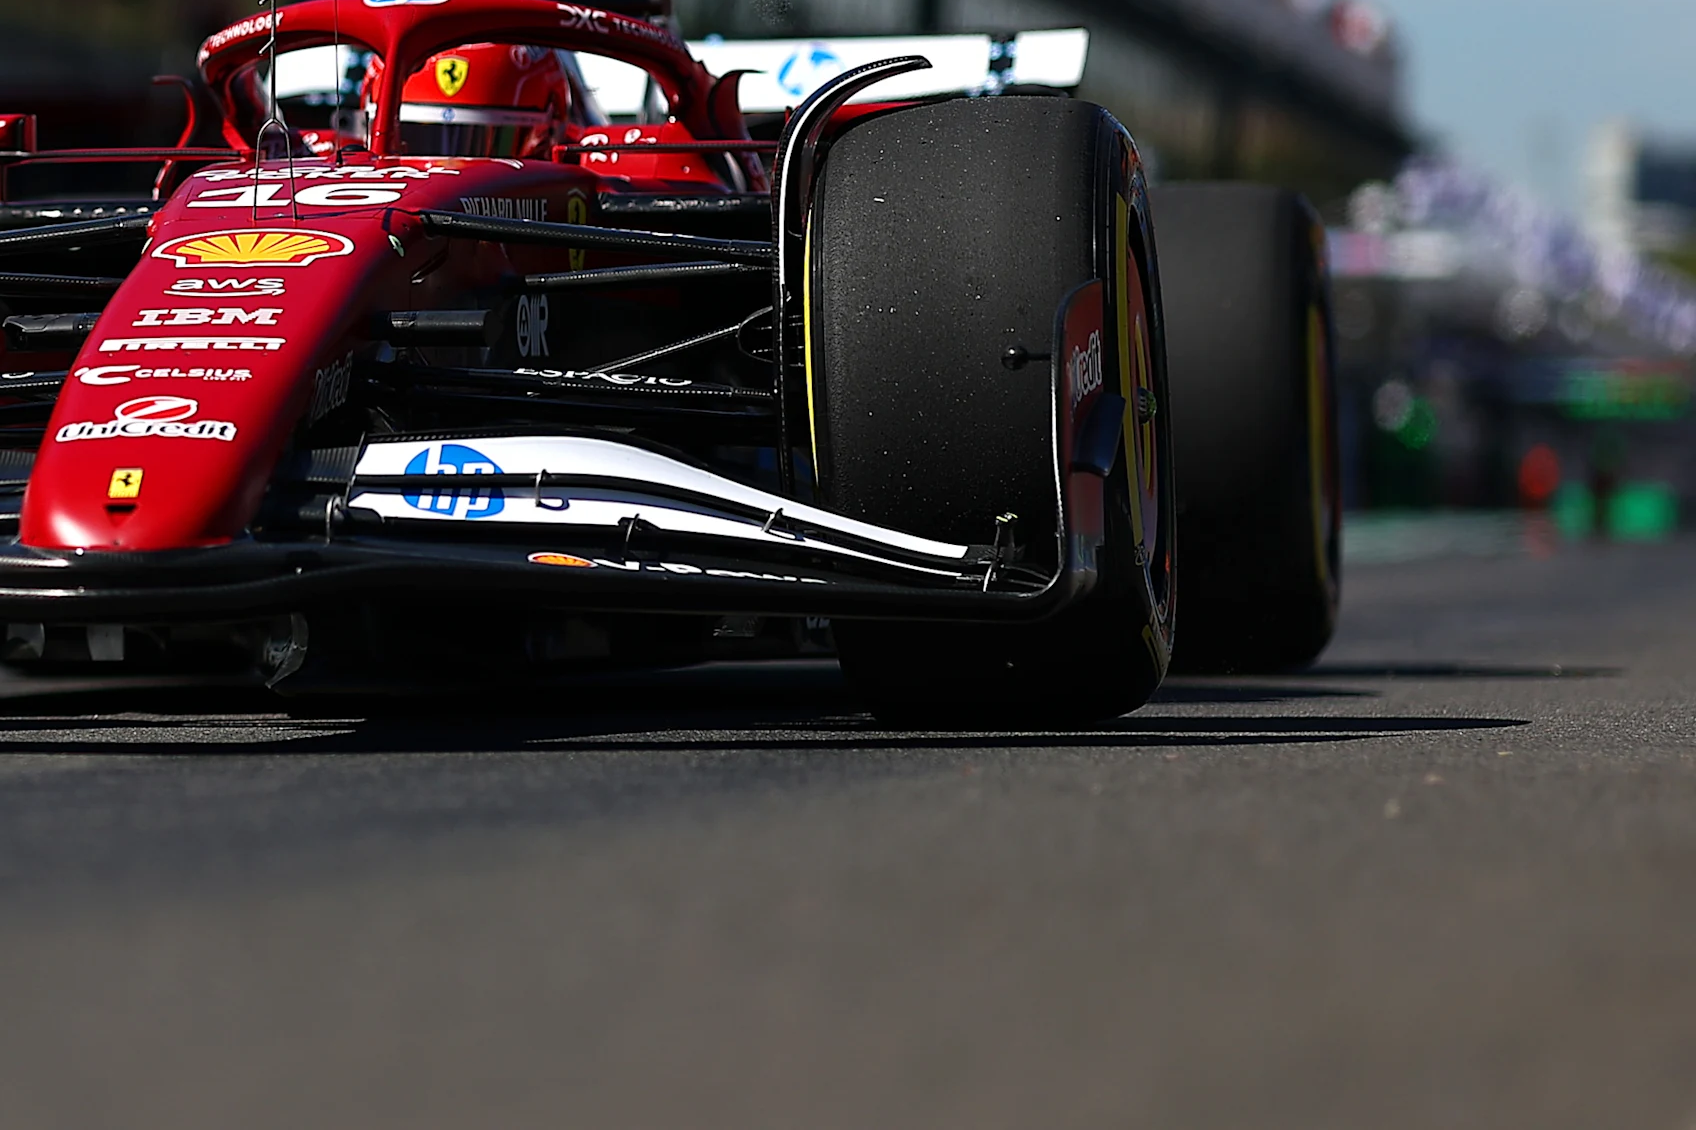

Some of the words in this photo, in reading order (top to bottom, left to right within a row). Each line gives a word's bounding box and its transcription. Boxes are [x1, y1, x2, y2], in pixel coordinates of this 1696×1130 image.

[556, 3, 609, 34] DXC
[187, 183, 407, 207] 16
[170, 278, 285, 291] aws
[132, 308, 284, 326] IBM
[99, 337, 287, 352] PIRELLI
[135, 368, 252, 378] CELSIUS
[57, 420, 237, 442] UniCredit
[411, 445, 500, 519] hp
